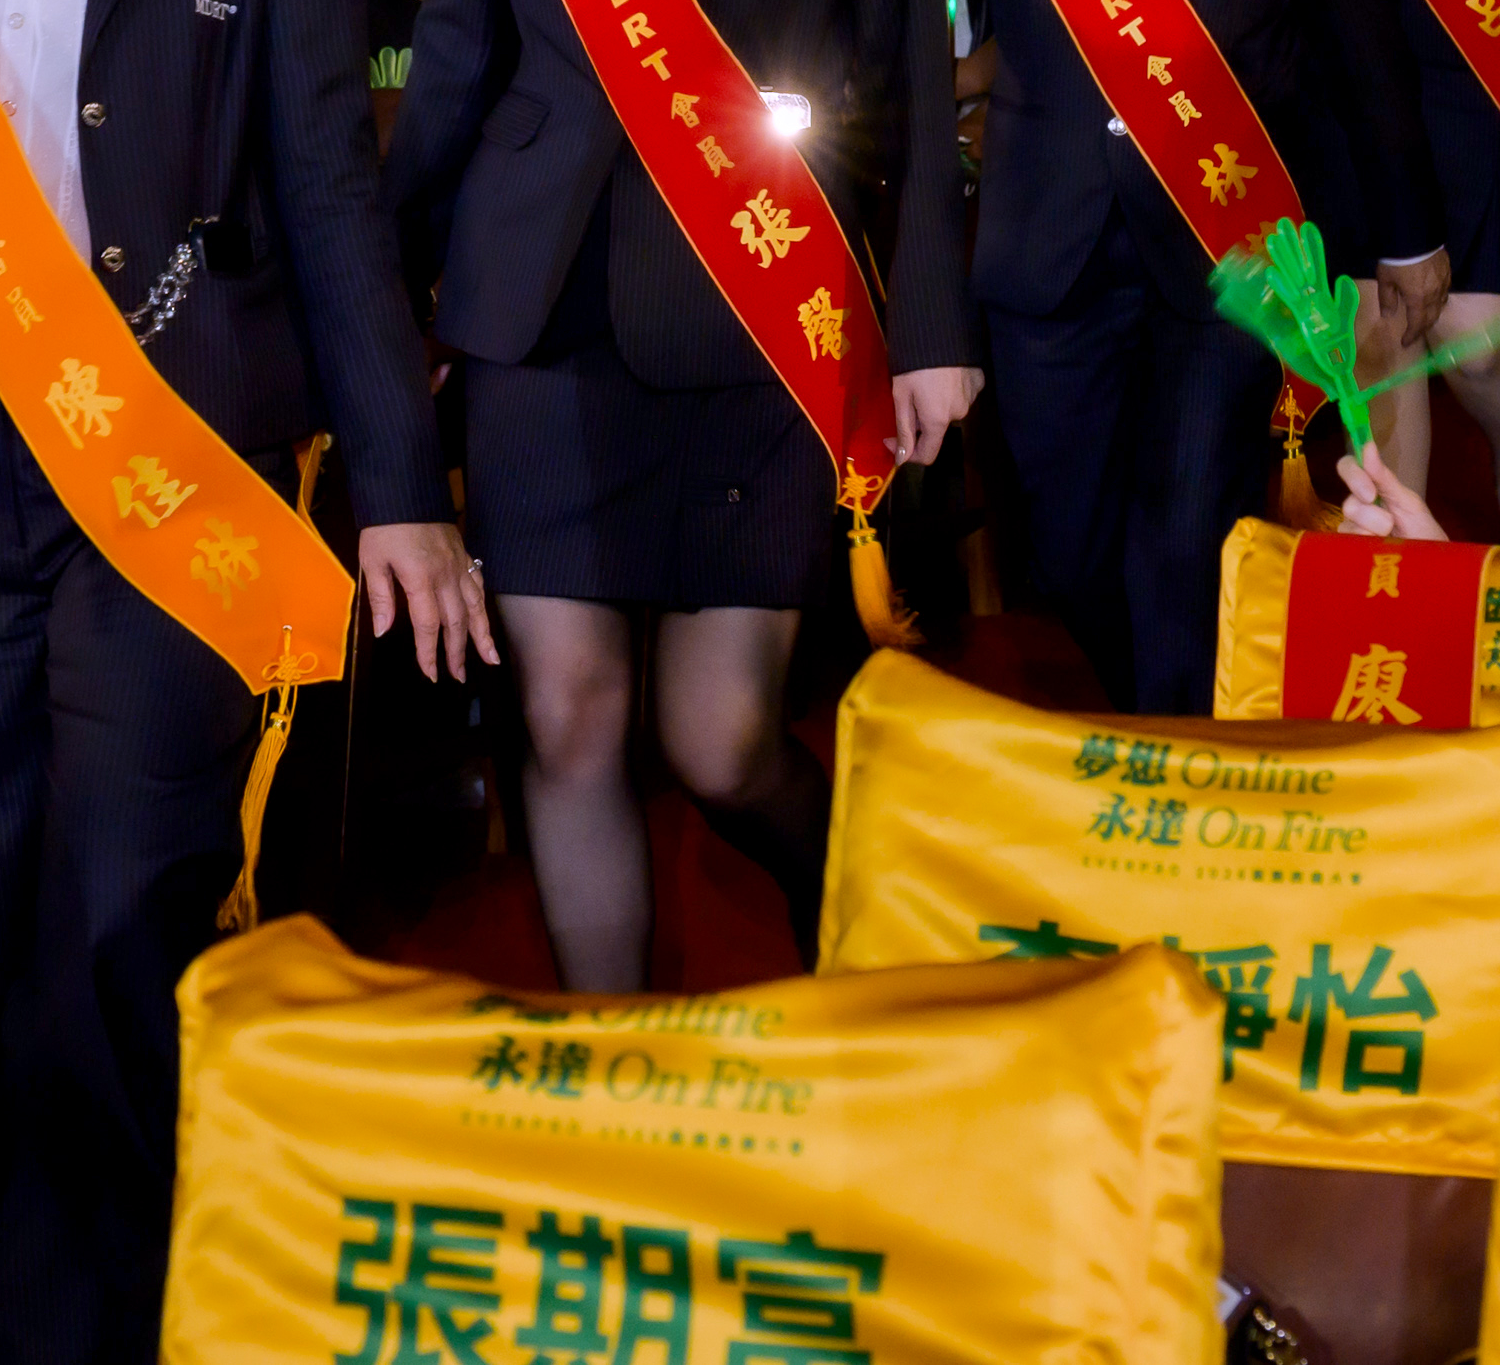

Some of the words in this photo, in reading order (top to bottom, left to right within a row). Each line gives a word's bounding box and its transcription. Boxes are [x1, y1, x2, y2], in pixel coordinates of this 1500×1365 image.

[1364, 552, 1403, 600] 員
[1180, 748, 1336, 795] Online
[1198, 806, 1267, 850] On
[1273, 809, 1369, 855] Fire
[605, 1047, 691, 1103] On
[698, 1055, 814, 1114] Fire
